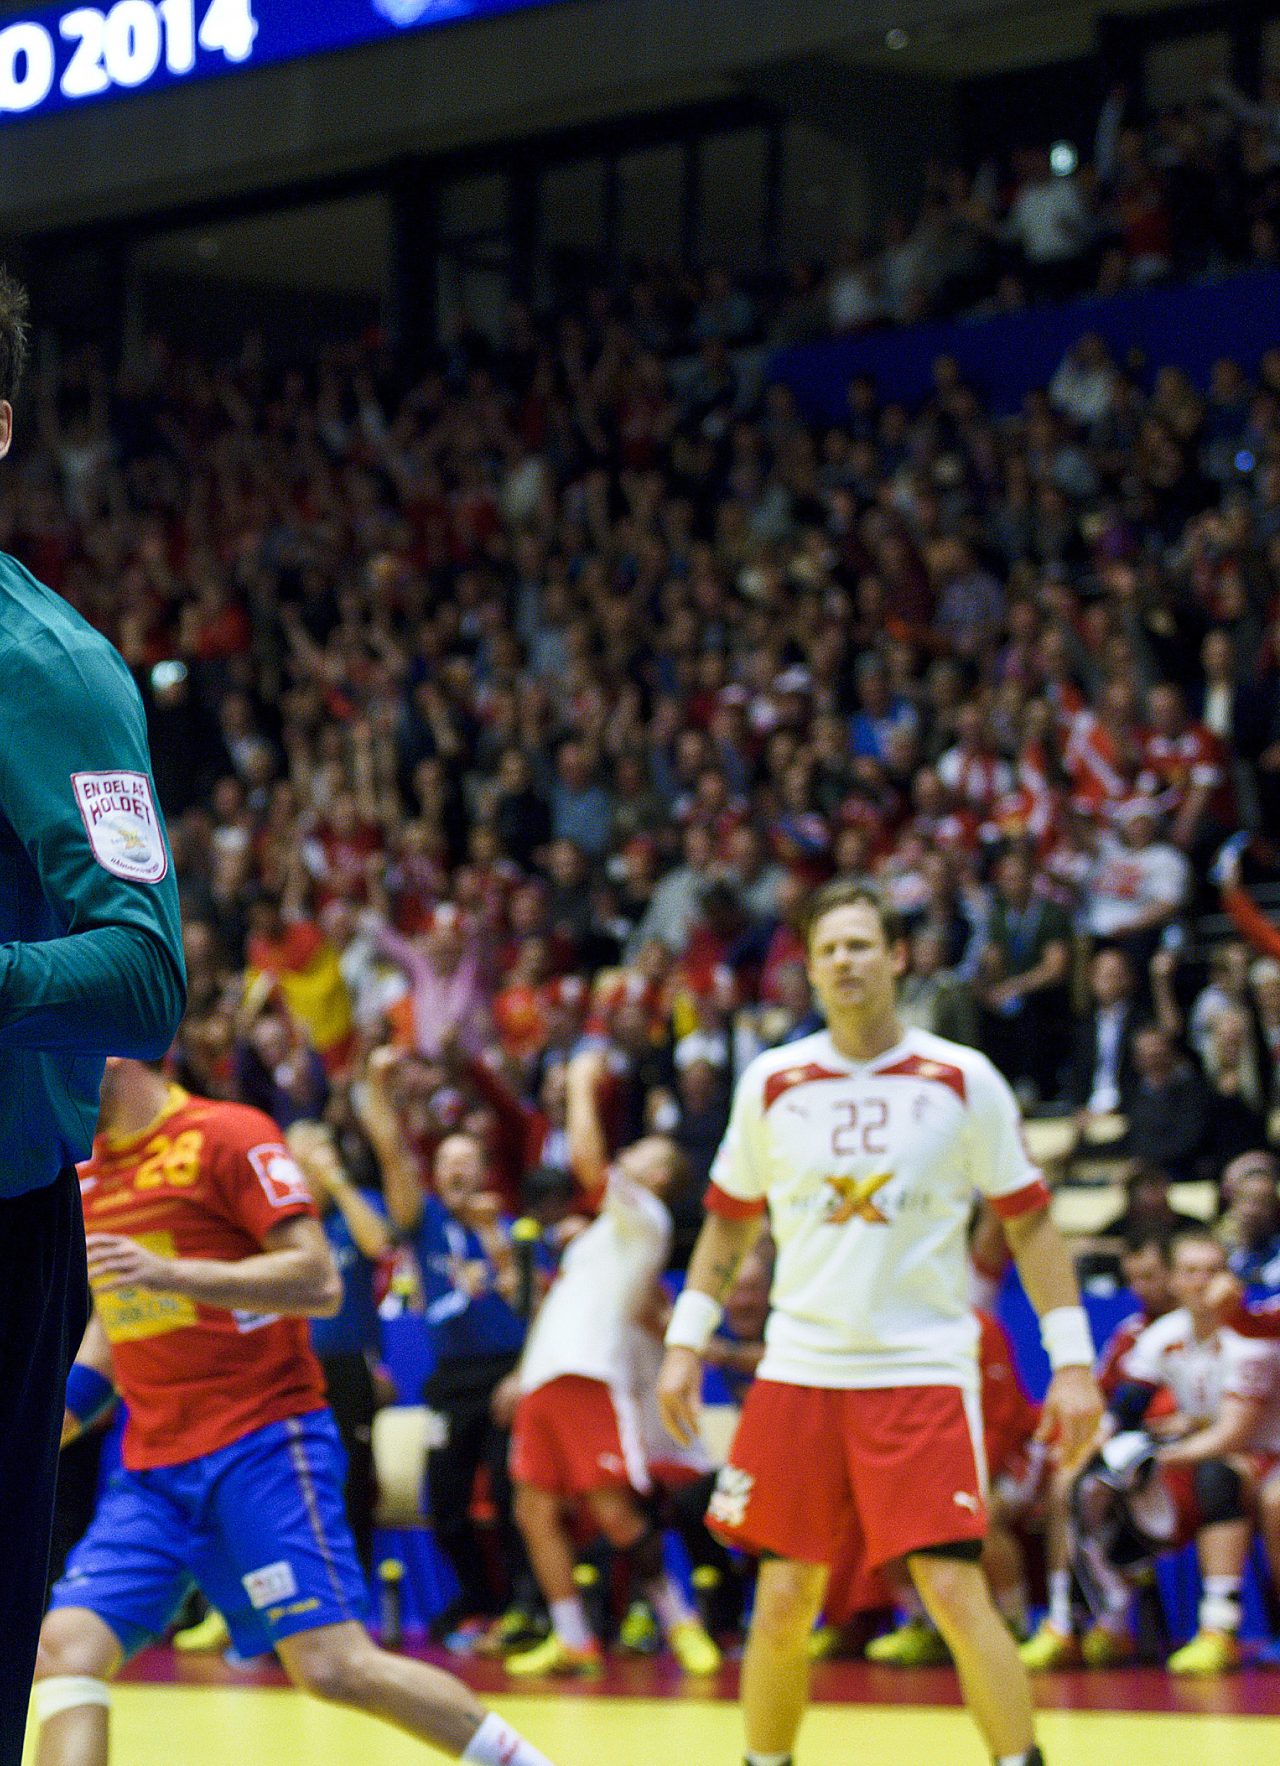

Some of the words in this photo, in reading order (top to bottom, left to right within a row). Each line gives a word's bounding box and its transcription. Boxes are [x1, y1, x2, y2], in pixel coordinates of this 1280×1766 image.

[59, 0, 258, 98] 2014
[83, 782, 101, 799] EN
[103, 780, 130, 794] DEL
[90, 796, 151, 827] HOLDET
[830, 1095, 890, 1157] 22
[133, 1129, 205, 1191] 28
